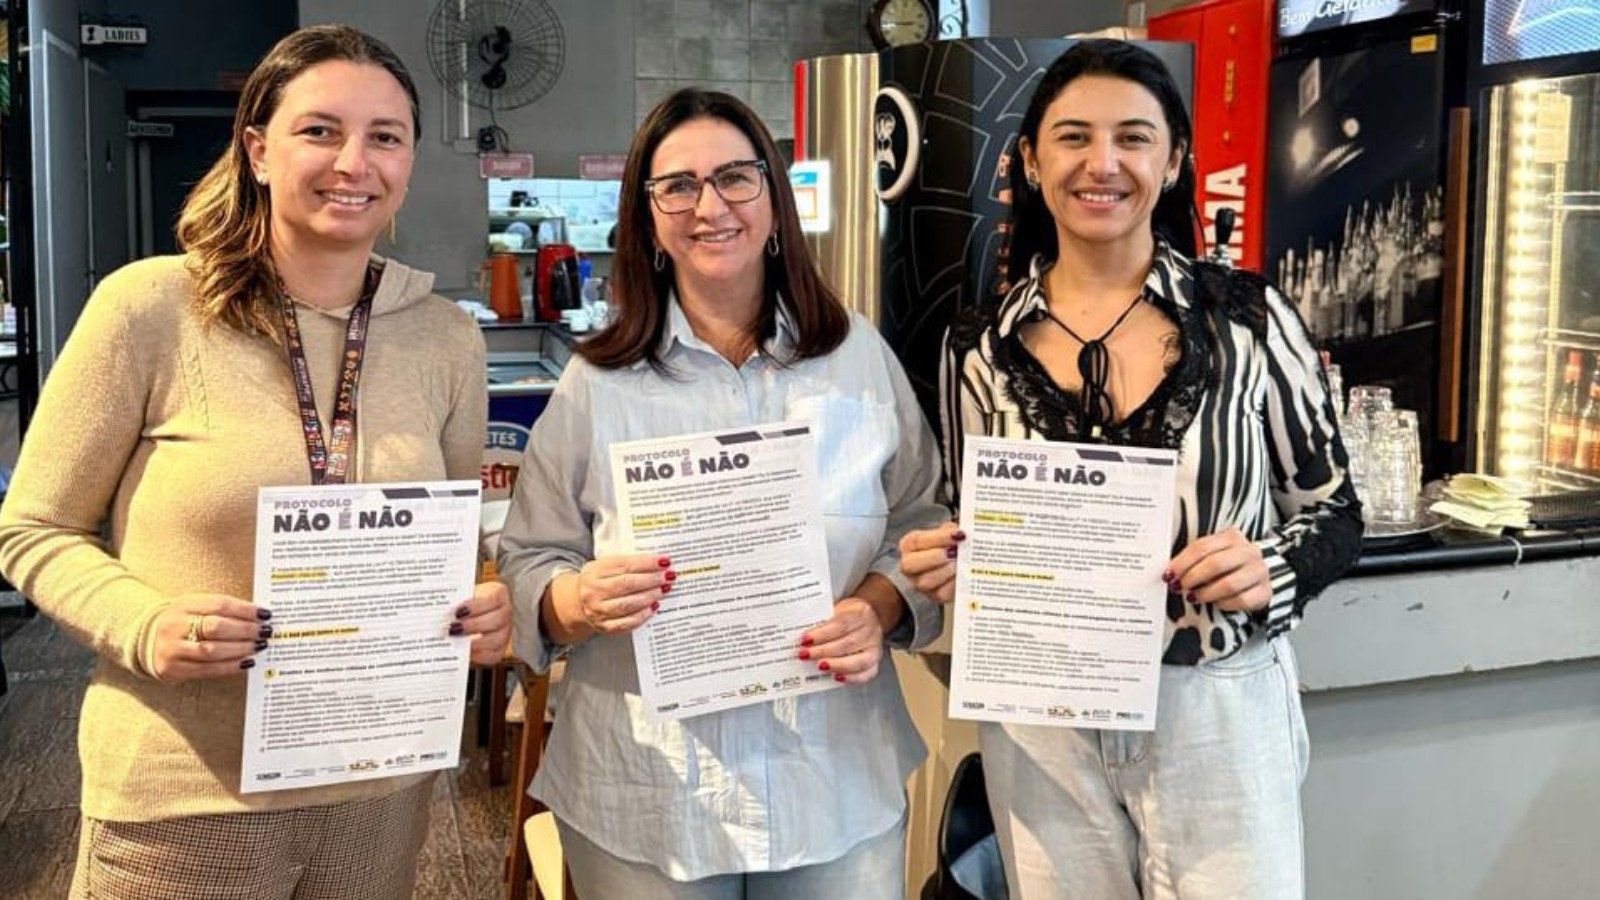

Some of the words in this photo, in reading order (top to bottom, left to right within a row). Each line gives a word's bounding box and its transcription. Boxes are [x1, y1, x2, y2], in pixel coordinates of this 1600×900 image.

[104, 29, 141, 41] LADIES
[623, 448, 690, 464] PROTOCOLO
[977, 449, 1048, 462] PROTOCOLO
[625, 461, 675, 484] NÃO
[680, 456, 694, 477] É
[699, 451, 750, 475] NÃO
[976, 459, 1028, 480] NÃO
[1034, 462, 1048, 482] É
[1054, 465, 1106, 486] NÃO
[274, 498, 352, 510] PROTOCOLO
[273, 509, 331, 533] NÃO
[338, 508, 352, 530] É
[358, 505, 413, 529] NÃO
